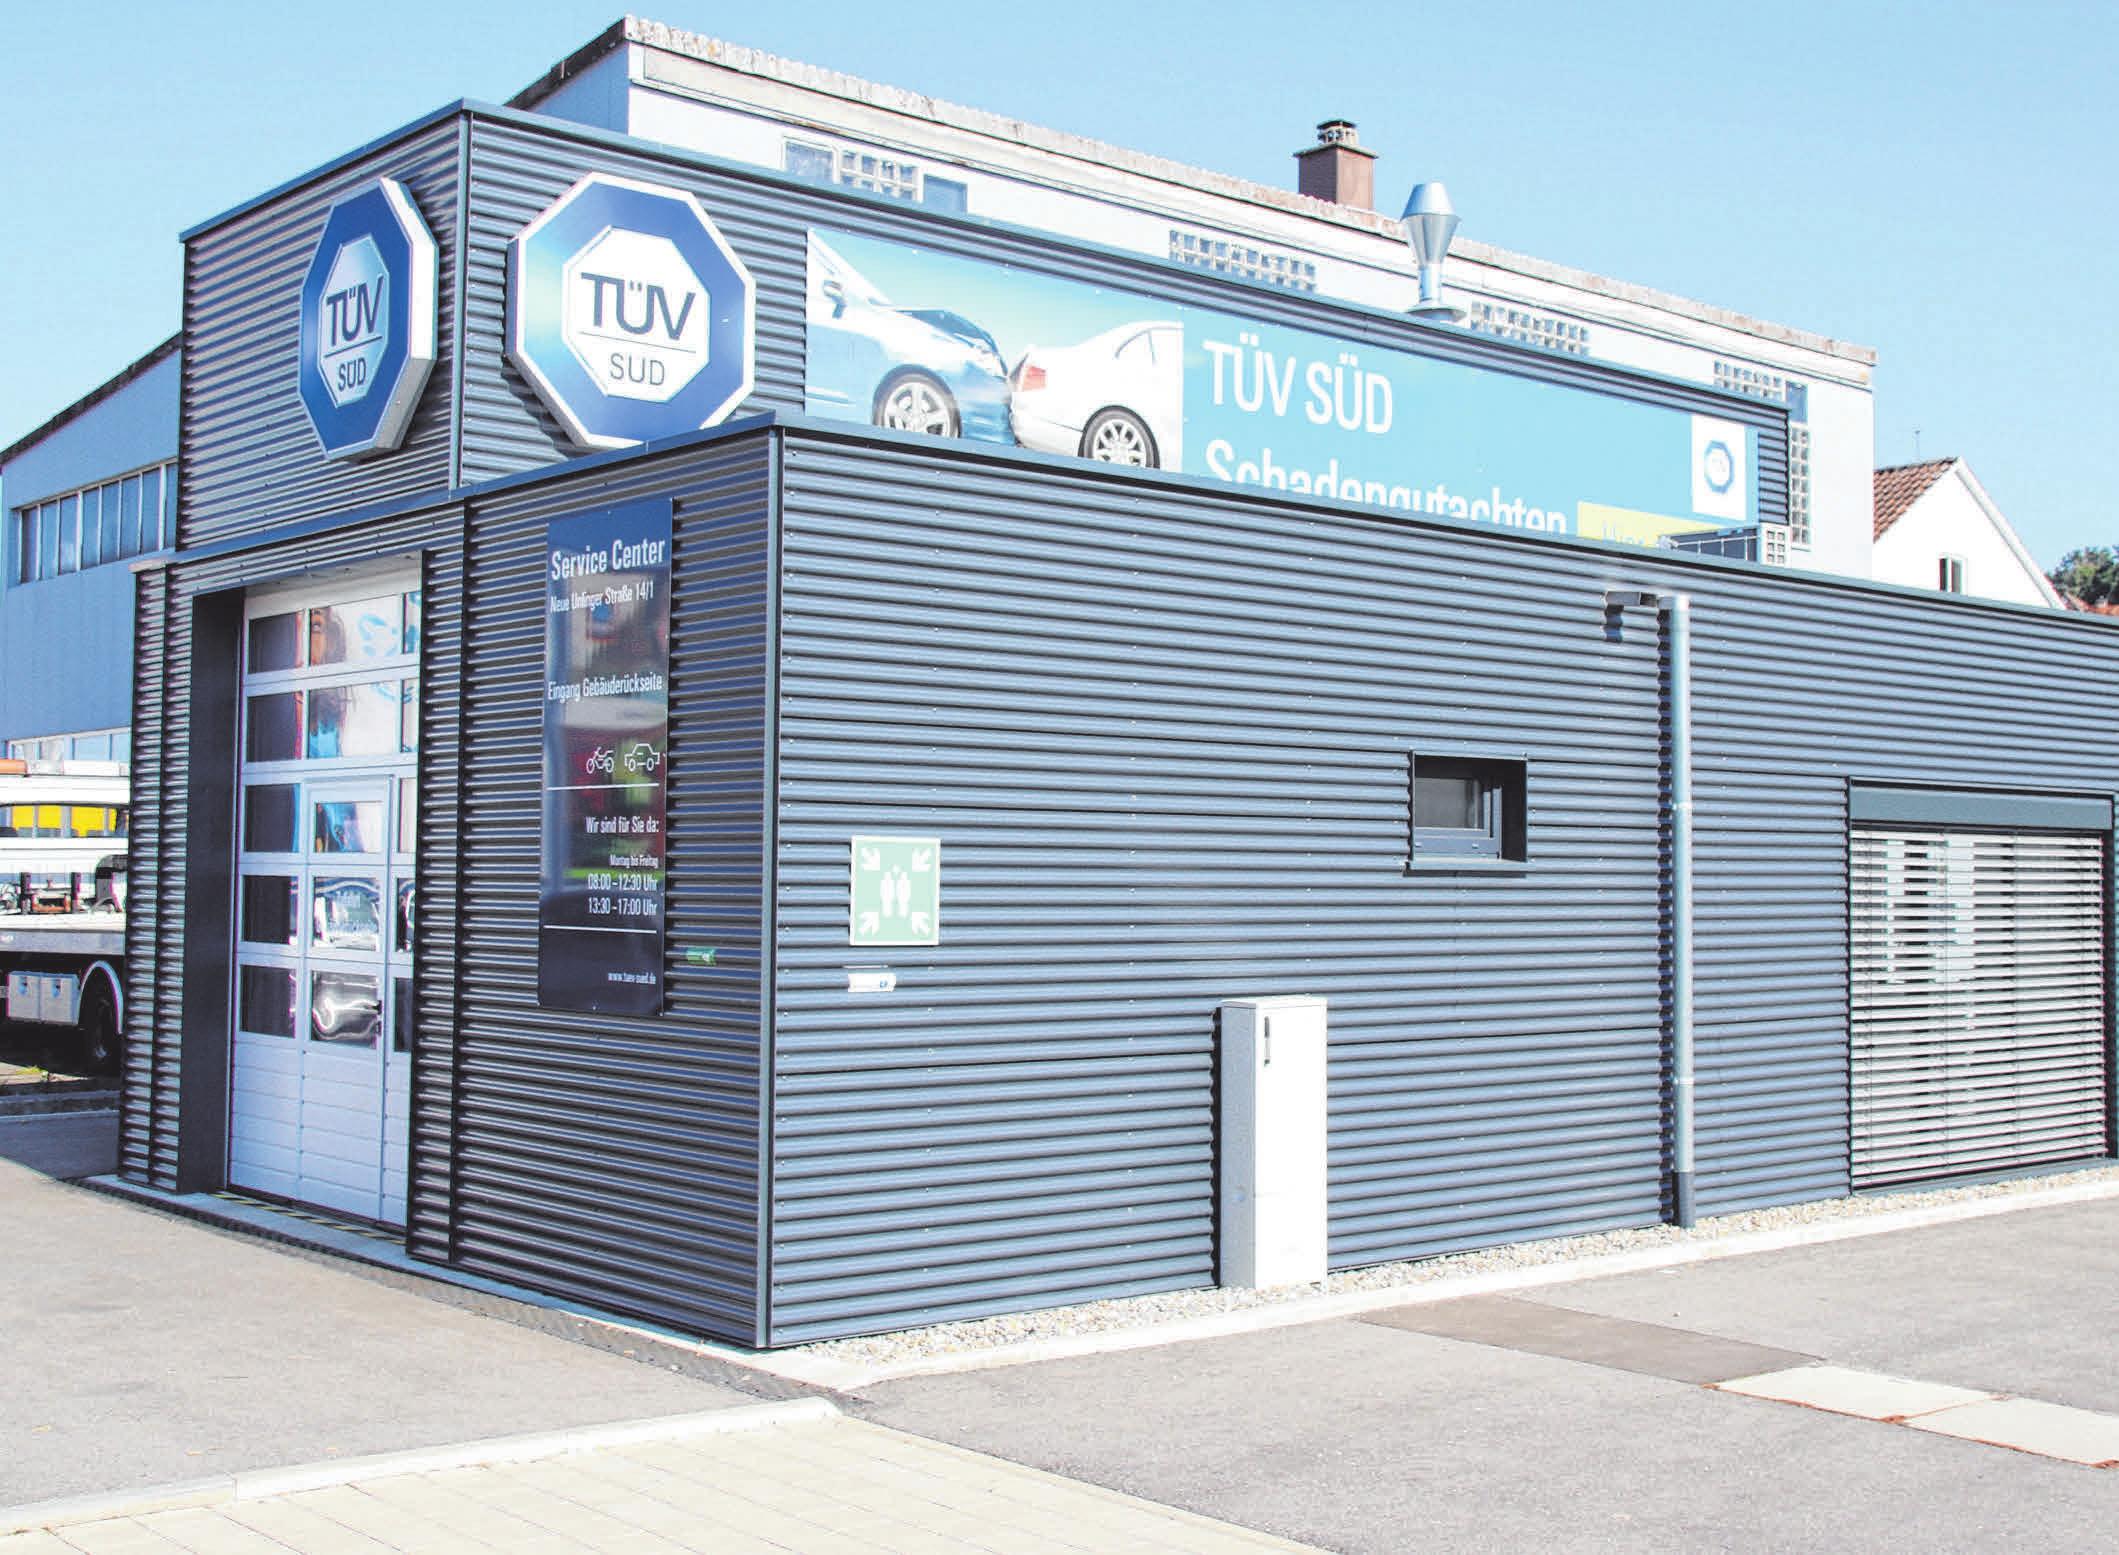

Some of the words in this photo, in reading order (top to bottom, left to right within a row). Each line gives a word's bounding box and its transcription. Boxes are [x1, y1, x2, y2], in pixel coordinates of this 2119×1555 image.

[326, 272, 384, 347] TÜV
[581, 272, 696, 340] TÜV
[1202, 332, 1297, 417] TÜV
[1304, 352, 1393, 433] SÜD
[551, 545, 608, 580] Service
[611, 538, 666, 571] Center
[550, 596, 570, 612] Neue
[604, 585, 633, 605] Straße
[636, 578, 654, 601] 14/1
[548, 680, 581, 703] Eingang
[582, 672, 663, 698] Gebäuderückseite
[585, 816, 599, 833] Wir
[600, 816, 617, 833] sind
[618, 815, 630, 833] für
[632, 815, 645, 833] Sie
[646, 815, 659, 833] da:
[618, 873, 641, 891] 12:30
[643, 873, 658, 892] Uhr
[588, 897, 611, 914] 13:30
[618, 898, 641, 915] 17:00
[643, 898, 658, 916] Uhr
